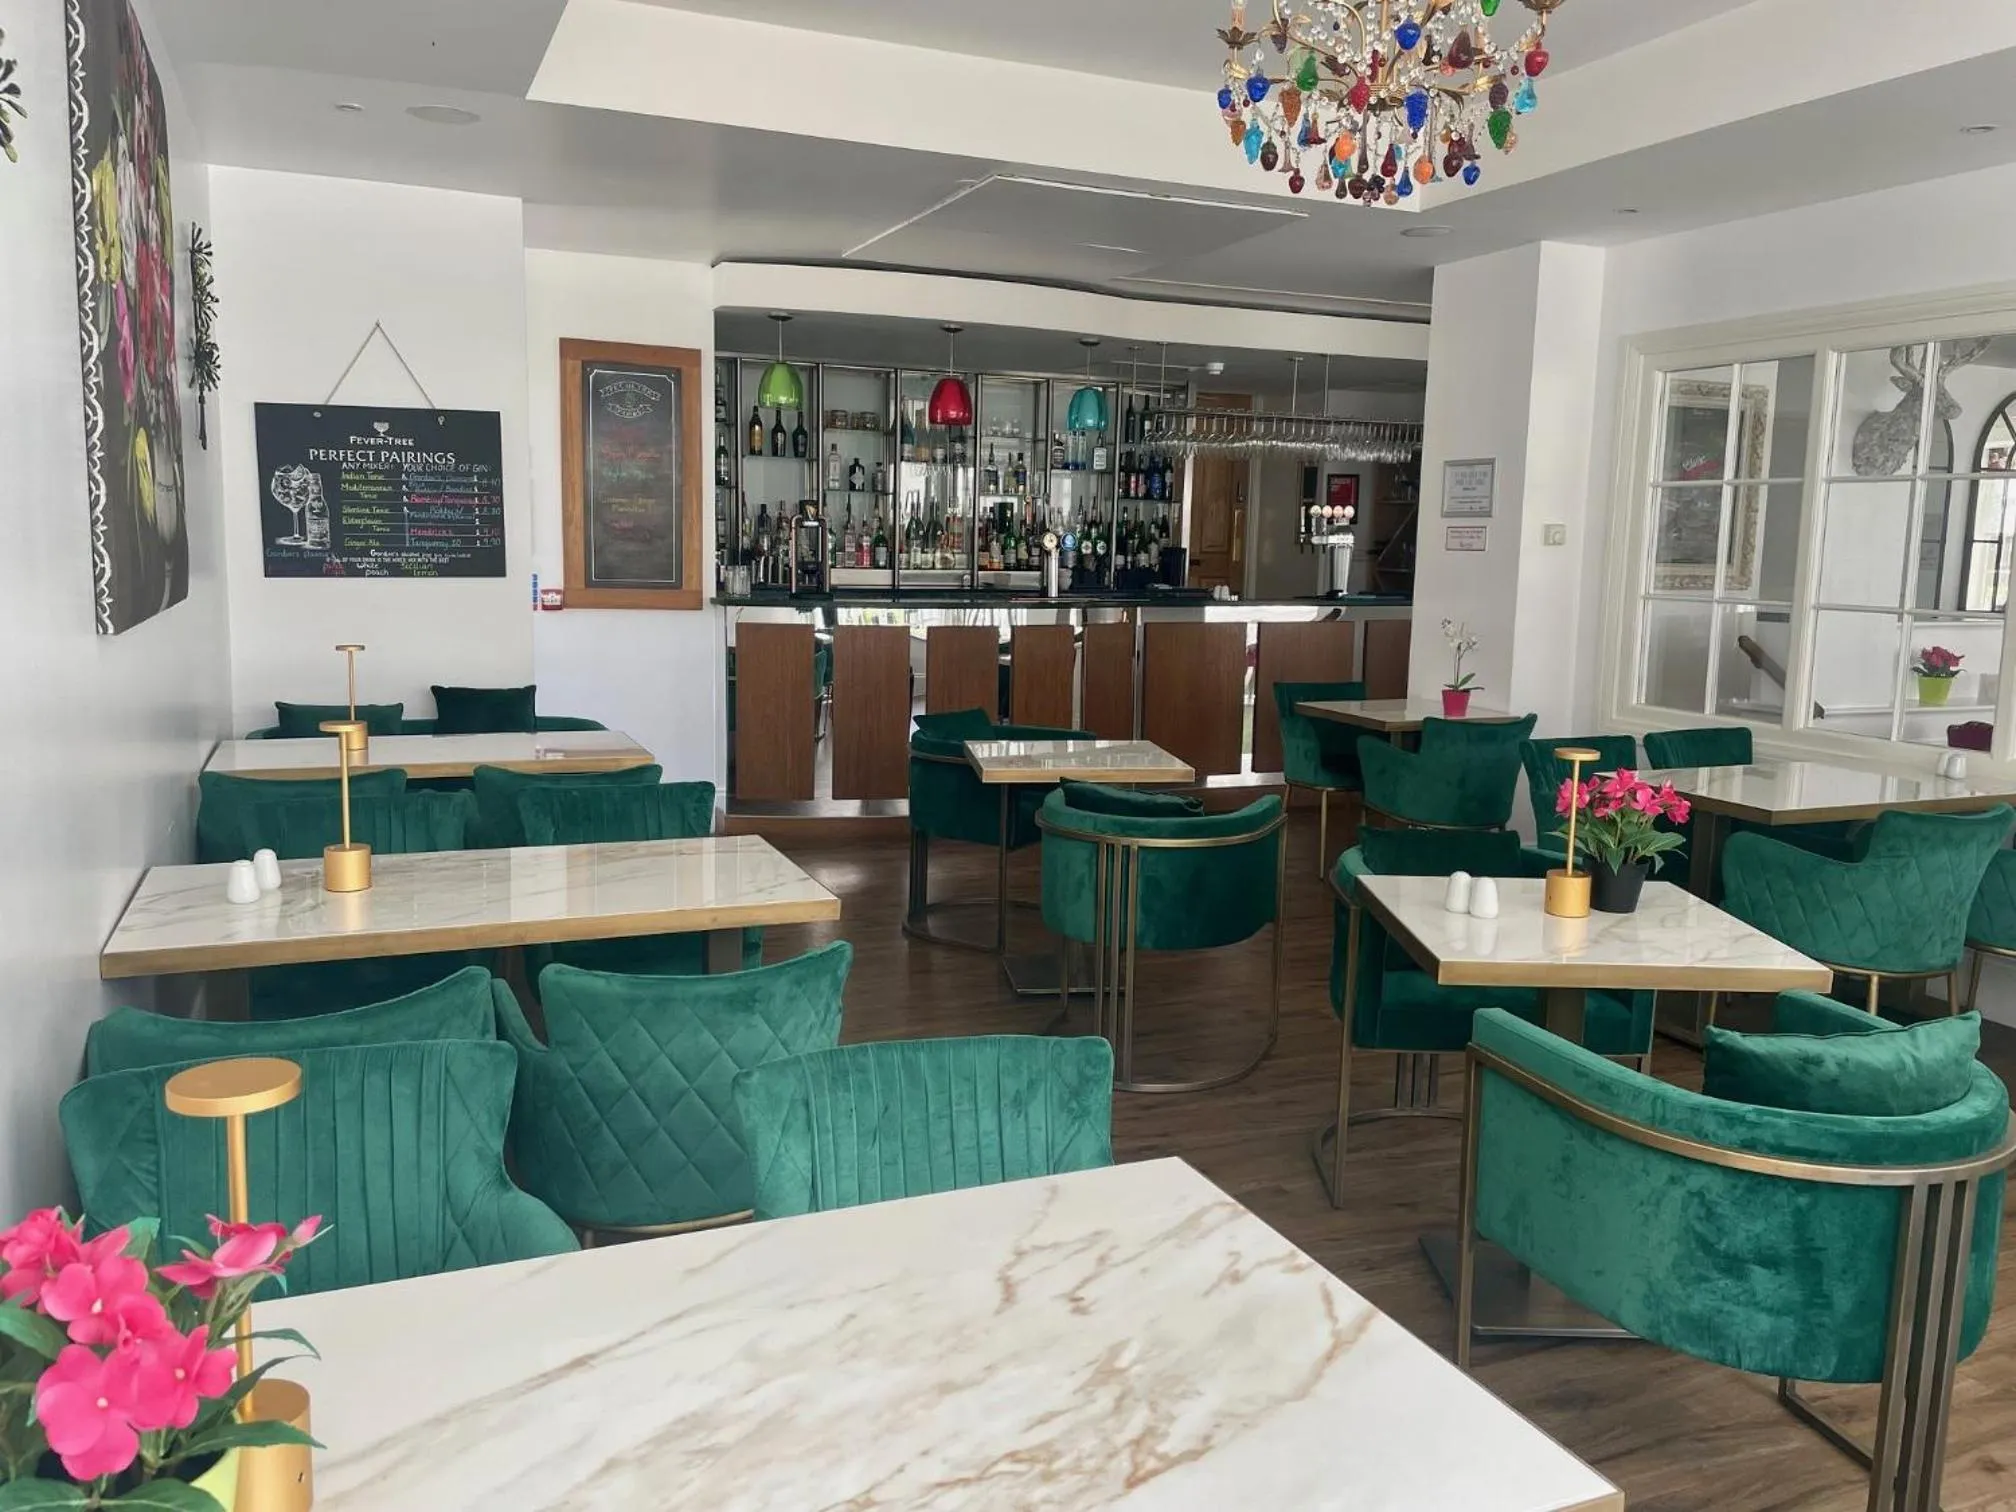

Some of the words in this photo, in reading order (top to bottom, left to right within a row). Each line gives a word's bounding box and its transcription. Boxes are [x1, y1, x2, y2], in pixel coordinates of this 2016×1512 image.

[350, 435, 414, 446] FEVER-TREE
[309, 448, 375, 462] PERFECT
[381, 450, 455, 465] PAIRINGS
[342, 462, 360, 470] ANY
[403, 463, 424, 472] YOUR
[425, 463, 457, 472] CHOICE
